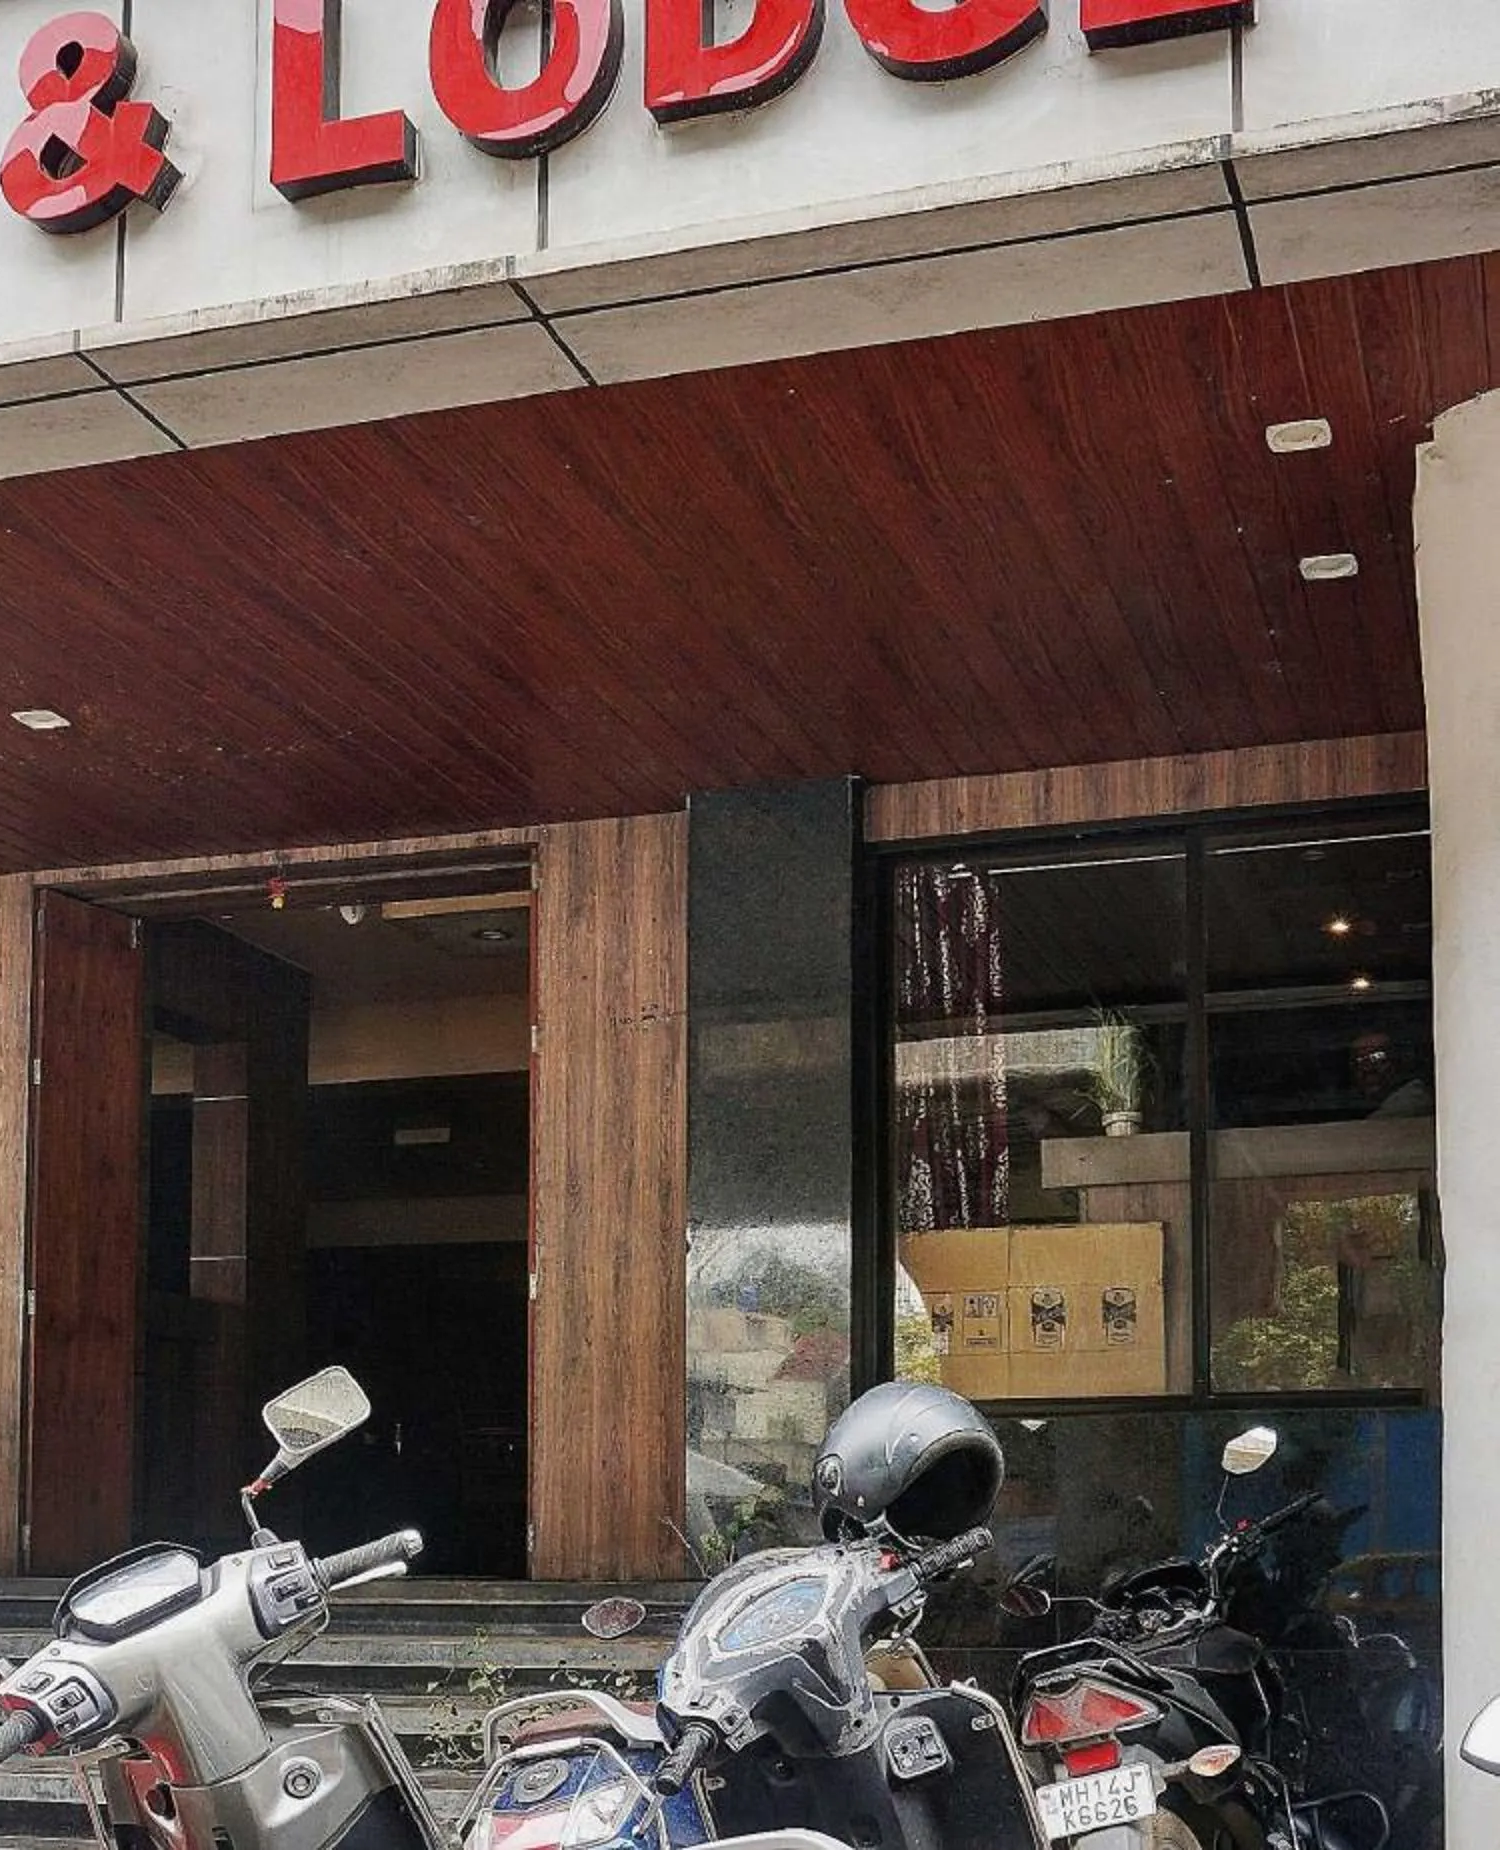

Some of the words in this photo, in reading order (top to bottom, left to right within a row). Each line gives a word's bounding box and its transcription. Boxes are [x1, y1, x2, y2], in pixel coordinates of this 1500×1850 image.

[0, 11, 183, 235] &
[1059, 1770, 1142, 1808] MH14J
[1063, 1795, 1139, 1831] K6626
